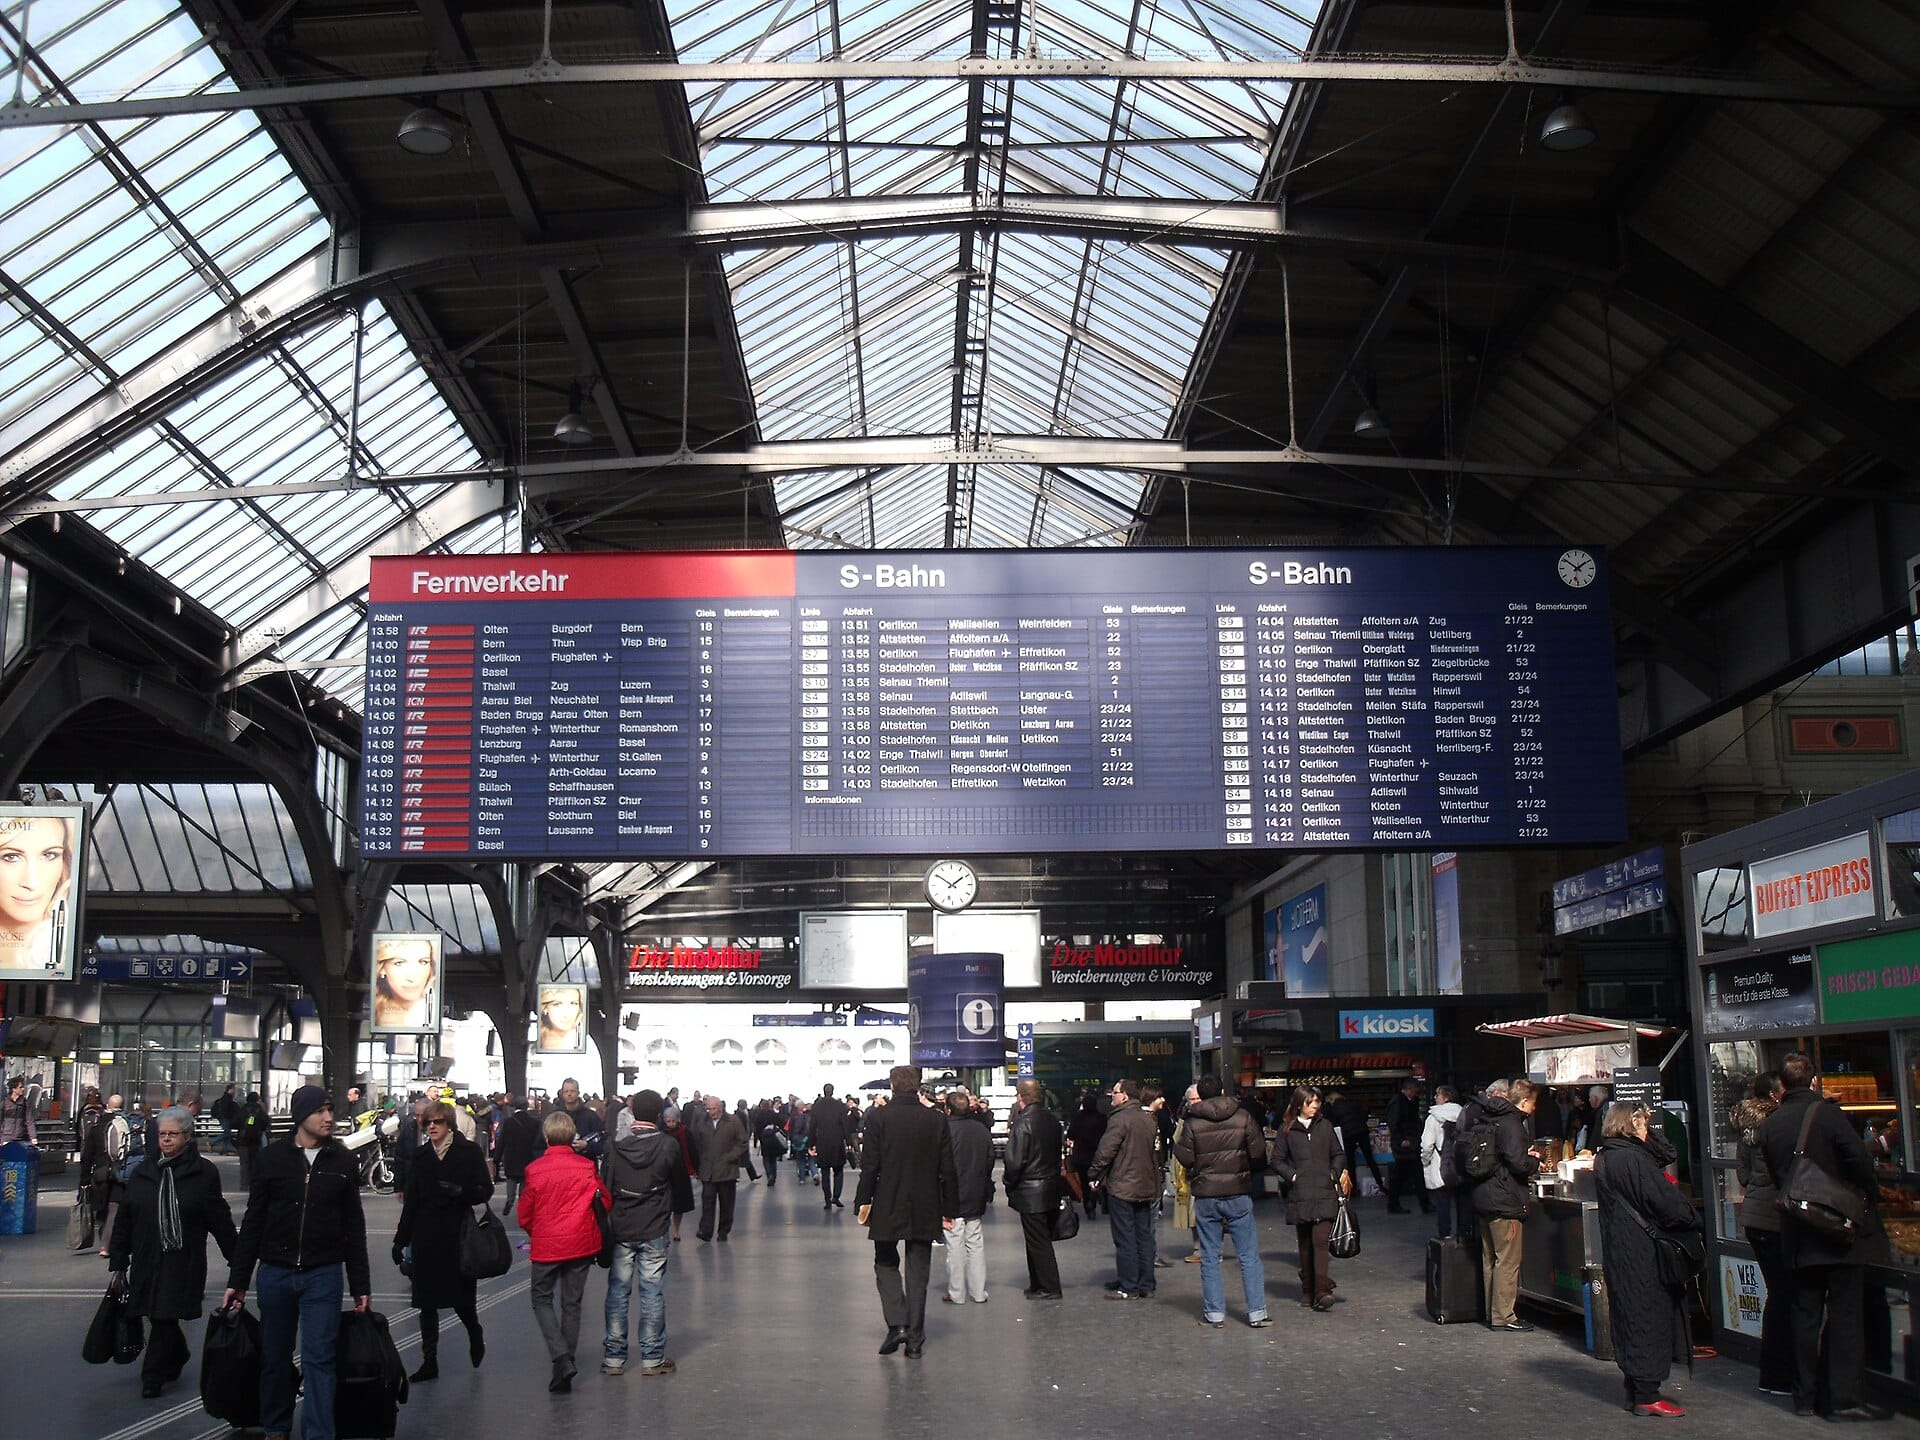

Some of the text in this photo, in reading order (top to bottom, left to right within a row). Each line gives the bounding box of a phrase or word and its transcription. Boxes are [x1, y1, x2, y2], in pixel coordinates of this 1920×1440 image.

[840, 565, 945, 588] S-Bahn
[1249, 562, 1351, 584] S-Bahn
[412, 570, 568, 594] Fernverkehr
[843, 608, 873, 616] Abfahrt
[1102, 606, 1123, 614] Gleis
[1131, 606, 1186, 614] Bemerkungen
[1258, 604, 1287, 612] Abfahrt
[1536, 603, 1588, 612] Bemerkungen
[374, 610, 780, 622] Abfahrt Gleis Bemerkungen
[1257, 617, 1284, 625] 14.04
[1294, 617, 1338, 625] Altstetten
[1362, 617, 1400, 625] Affoltern
[1429, 617, 1446, 626] Zug
[1505, 616, 1532, 624] 21/22
[372, 627, 398, 635] 13.58
[552, 624, 592, 634] Burgdorf
[622, 624, 643, 632] Bern
[701, 623, 712, 631] 18
[842, 633, 1120, 644] 13.52 Altstetten Affoltern a/A 22
[371, 655, 395, 663] 14.01
[483, 654, 520, 662] Oerlikon
[552, 653, 597, 662] Flughafen
[842, 647, 1120, 658] 13.55 Oerlikon Flughafen Effretikon 52
[483, 682, 515, 690] Thalwil
[551, 682, 568, 691] Zug
[621, 681, 650, 689] Luzern
[842, 693, 870, 701] 13.58
[842, 704, 1130, 715] 13.58 Stadelhofen Stettbach Uster 23/24
[1260, 702, 1287, 711] 14.12
[1298, 702, 1352, 710] Stadelhofen
[1366, 702, 1396, 710] Meilen
[1434, 701, 1483, 710] Rapperswil
[1511, 700, 1539, 708] 23/24
[1261, 717, 1288, 725] 14.13
[1298, 716, 1344, 725] Altstetten
[1367, 716, 1404, 724] Dietikon
[1470, 715, 1496, 724] Brugg
[1512, 714, 1540, 722] 21/22
[368, 723, 712, 735] 14.07 Flughafen Winterthur Romanshorn 10
[368, 741, 394, 749] 14.08
[480, 740, 521, 749] Lenzburg
[620, 738, 645, 746] Basel
[700, 738, 711, 746] 12
[1263, 743, 1542, 754] 14.15 Stadelhofen Küsnacht Herrliberg-F. 23/24
[480, 769, 497, 778] Zug
[550, 768, 606, 776] Arth-Goldau
[619, 768, 656, 776] Locarno
[1264, 771, 1544, 783] 14.18 Stadelhofen Winterthur Seuzach 23/24
[366, 781, 711, 792] 14.10 Bülach Schaffhausen 13
[843, 777, 1133, 788] 14.03 Stadelhofen Effretikon Wetzikon 23/24
[805, 796, 862, 804] Informationen
[1265, 800, 1546, 812] 14.20 Oerlikon Kloten Winterthur 21/22
[366, 810, 711, 821] 14.30 Olten Solothurn Biel 16
[1756, 857, 1871, 916] BUFFET EXPRESS
[628, 945, 763, 970] Die Mobiliar
[1052, 944, 1183, 967] Die Mobiliar
[629, 971, 791, 990] Versicherungen & Vorsorge
[1051, 969, 1213, 986] Versicherungen & Vorsorge
[1734, 974, 1755, 986] Premium
[1827, 970, 1877, 995] FRISCH
[1722, 993, 1734, 1005] Nicht
[1758, 991, 1771, 1000] erste
[1344, 1014, 1429, 1034] k kiosk
[1020, 1043, 1030, 1052] 21
[1020, 1066, 1032, 1074] 24
